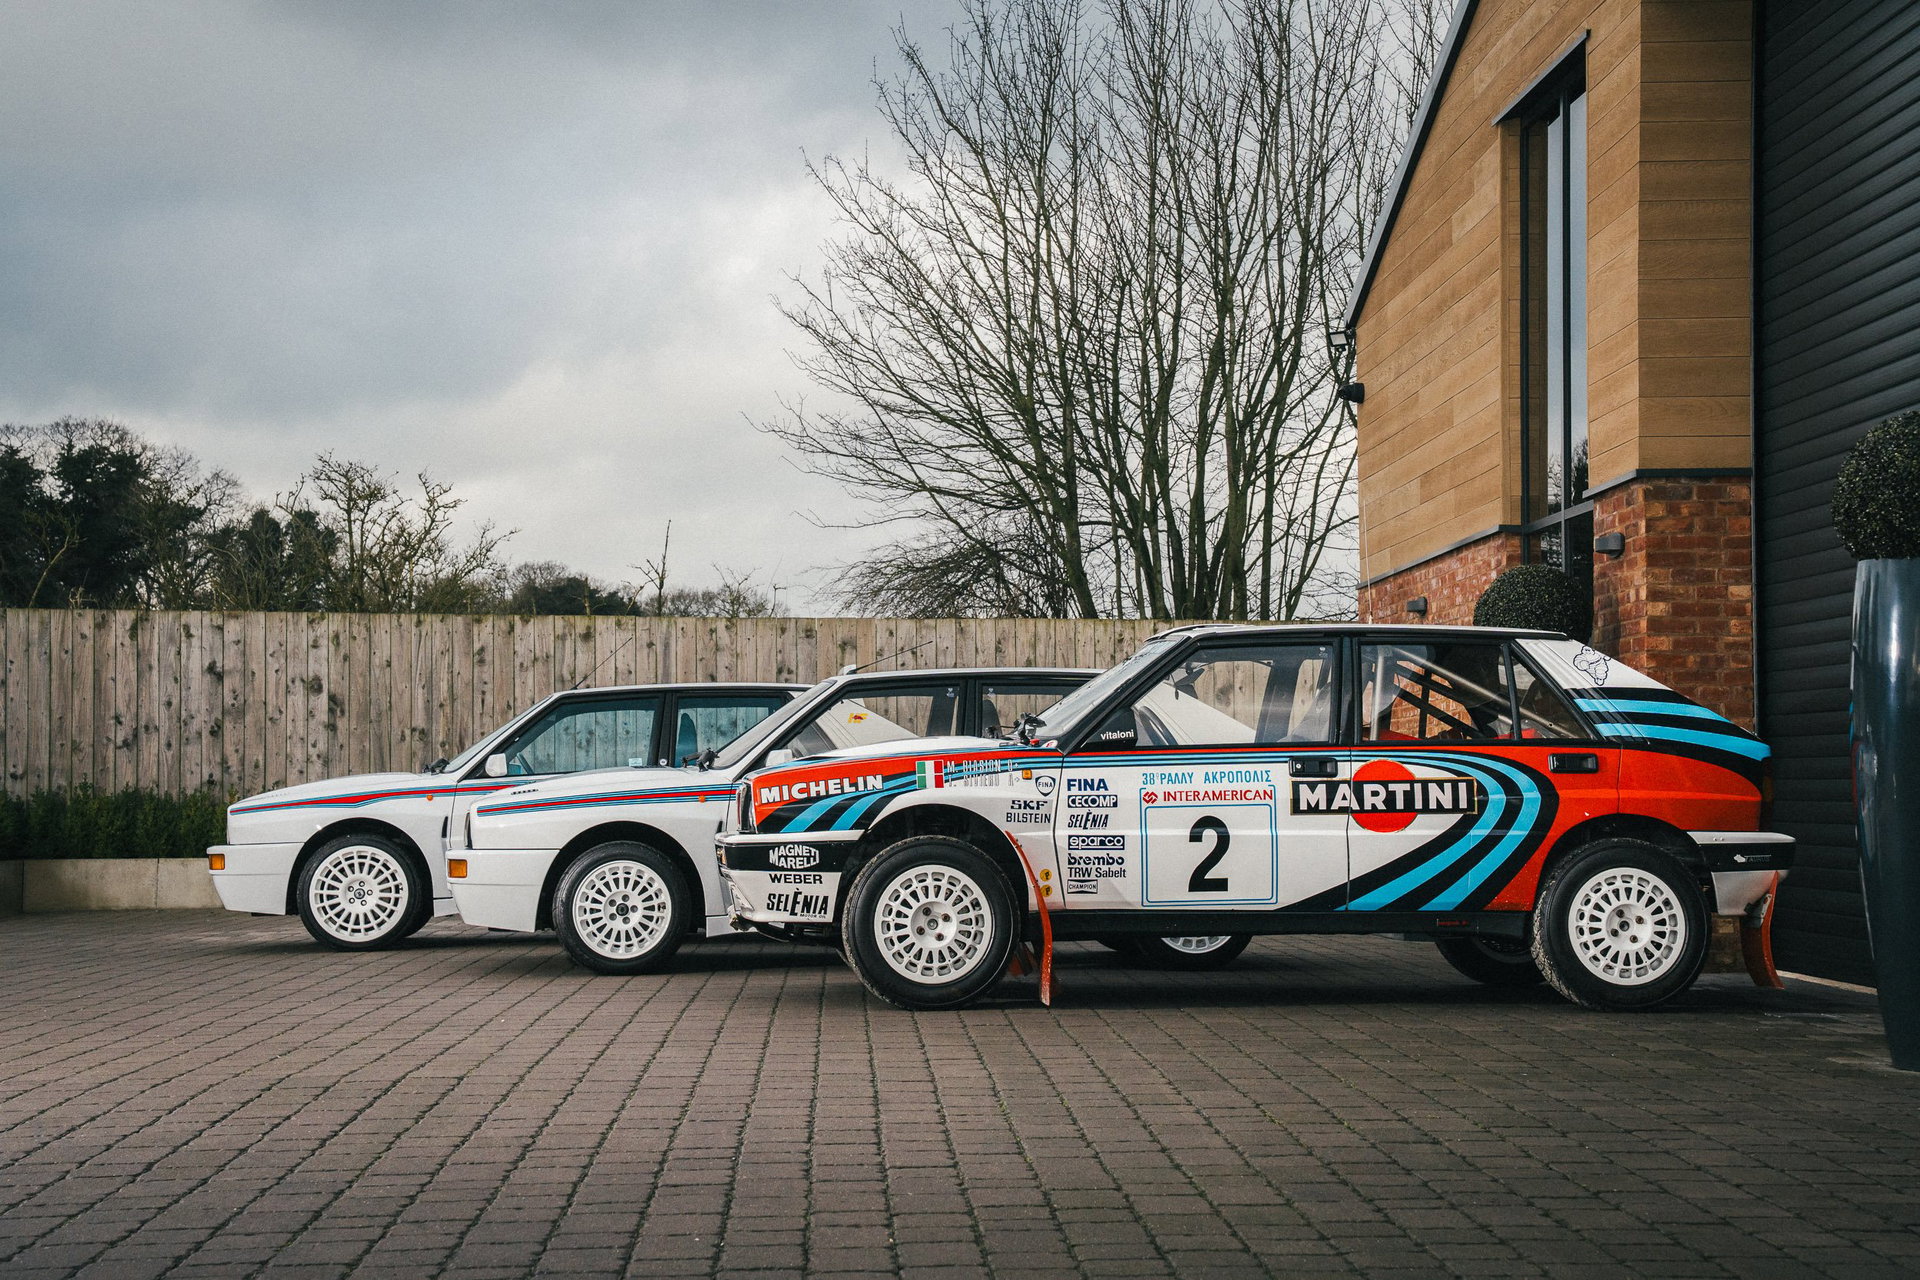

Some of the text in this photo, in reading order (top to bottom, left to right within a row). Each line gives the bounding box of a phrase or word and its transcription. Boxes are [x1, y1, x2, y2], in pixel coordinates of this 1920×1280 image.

[1100, 729, 1135, 740] vitaloni
[1203, 769, 1272, 784] ΑΚΡΟΠΟΛΙΣ
[760, 774, 883, 804] MICHELIN
[1067, 778, 1109, 791] FINA
[1068, 795, 1117, 807] CECOMP
[1163, 789, 1273, 802] INTERAMERICAN
[1299, 782, 1468, 811] MARTINI
[1010, 799, 1048, 810] SKF
[1006, 812, 1051, 823] BILSTEIN
[1069, 836, 1123, 850] sparco
[1067, 852, 1125, 866] brembo
[1188, 815, 1230, 892] 2
[768, 873, 823, 884] WEBER
[1067, 867, 1126, 878] TRW Sabelt
